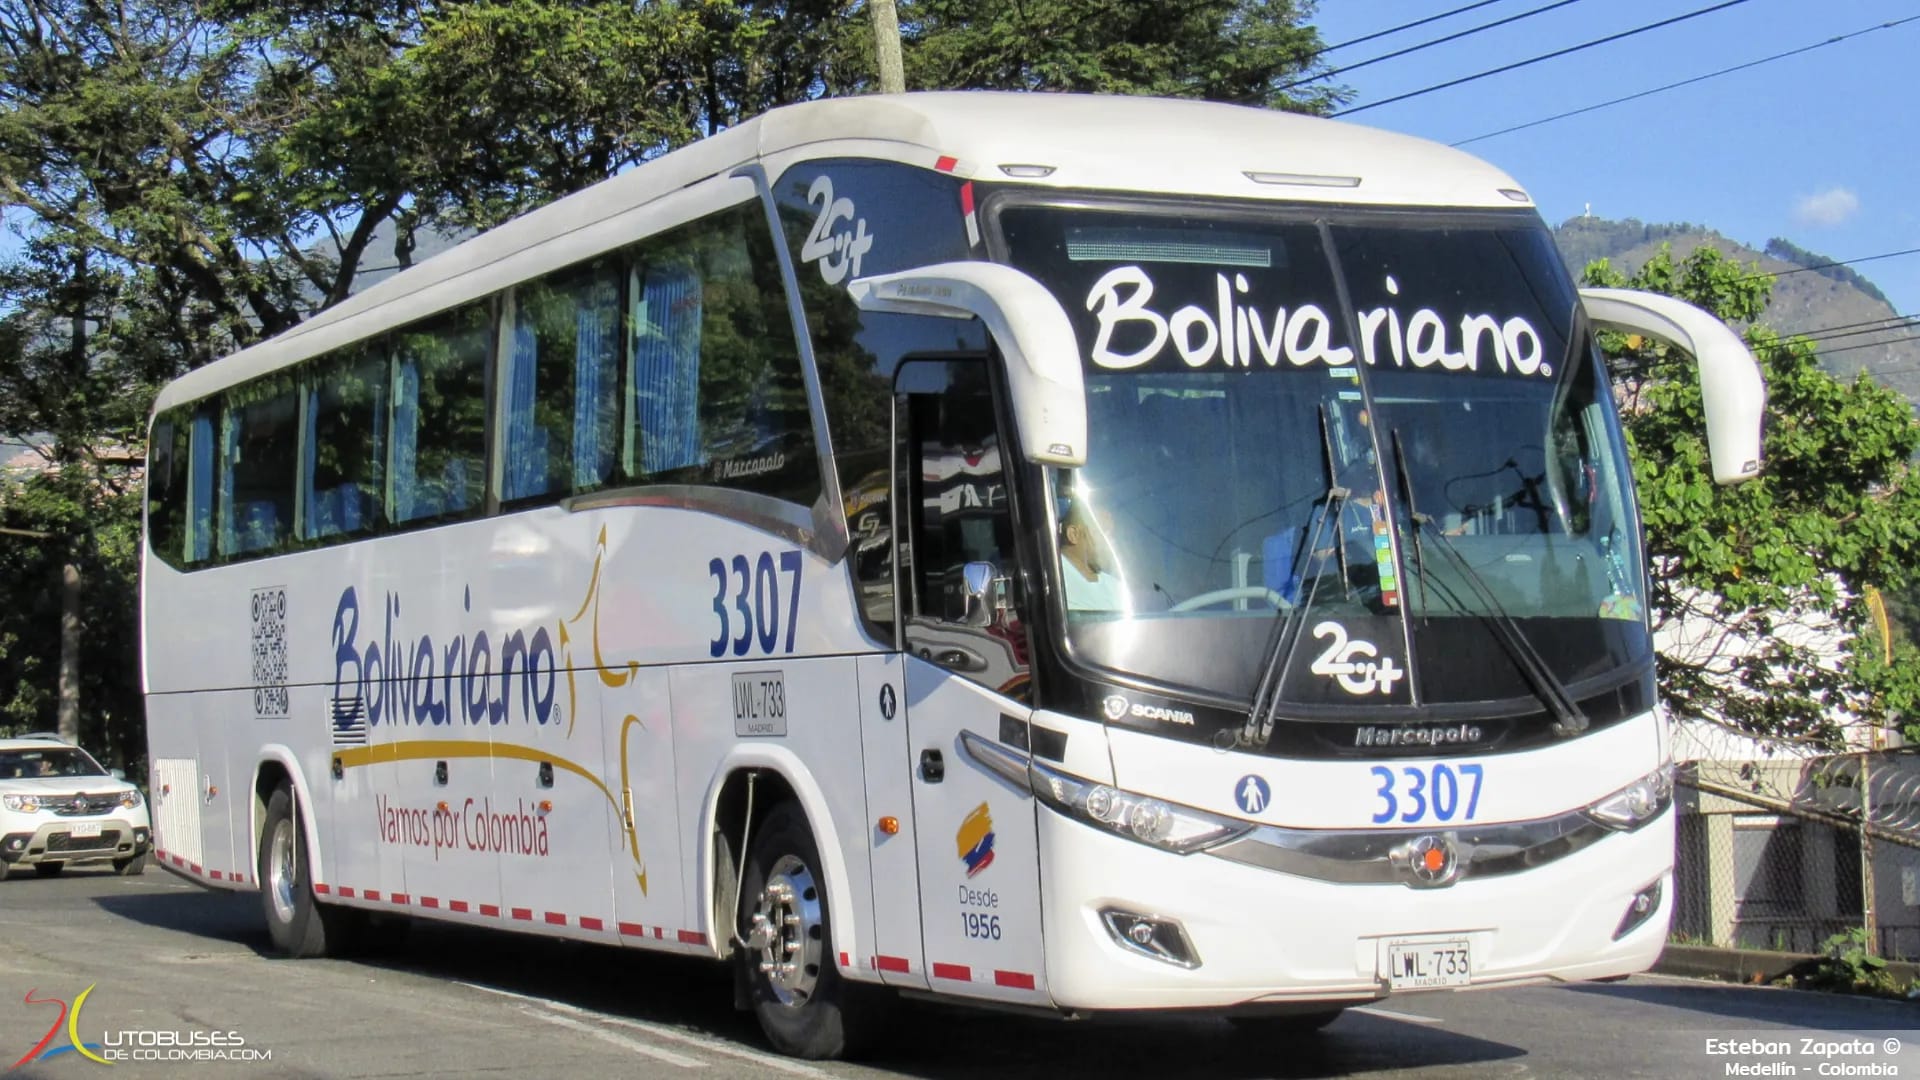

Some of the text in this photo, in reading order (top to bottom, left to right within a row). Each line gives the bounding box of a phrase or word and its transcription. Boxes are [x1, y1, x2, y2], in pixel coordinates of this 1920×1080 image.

[723, 452, 785, 479] Marcopolo
[709, 550, 802, 657] 3307
[1131, 703, 1195, 725] SCANIA
[1355, 724, 1480, 745] Marcopolo
[1370, 763, 1484, 824] 3307
[376, 794, 549, 861] Vamos por Colombia
[959, 885, 998, 908] Desde
[961, 912, 1001, 940] 1956
[1414, 978, 1447, 986] MADRID
